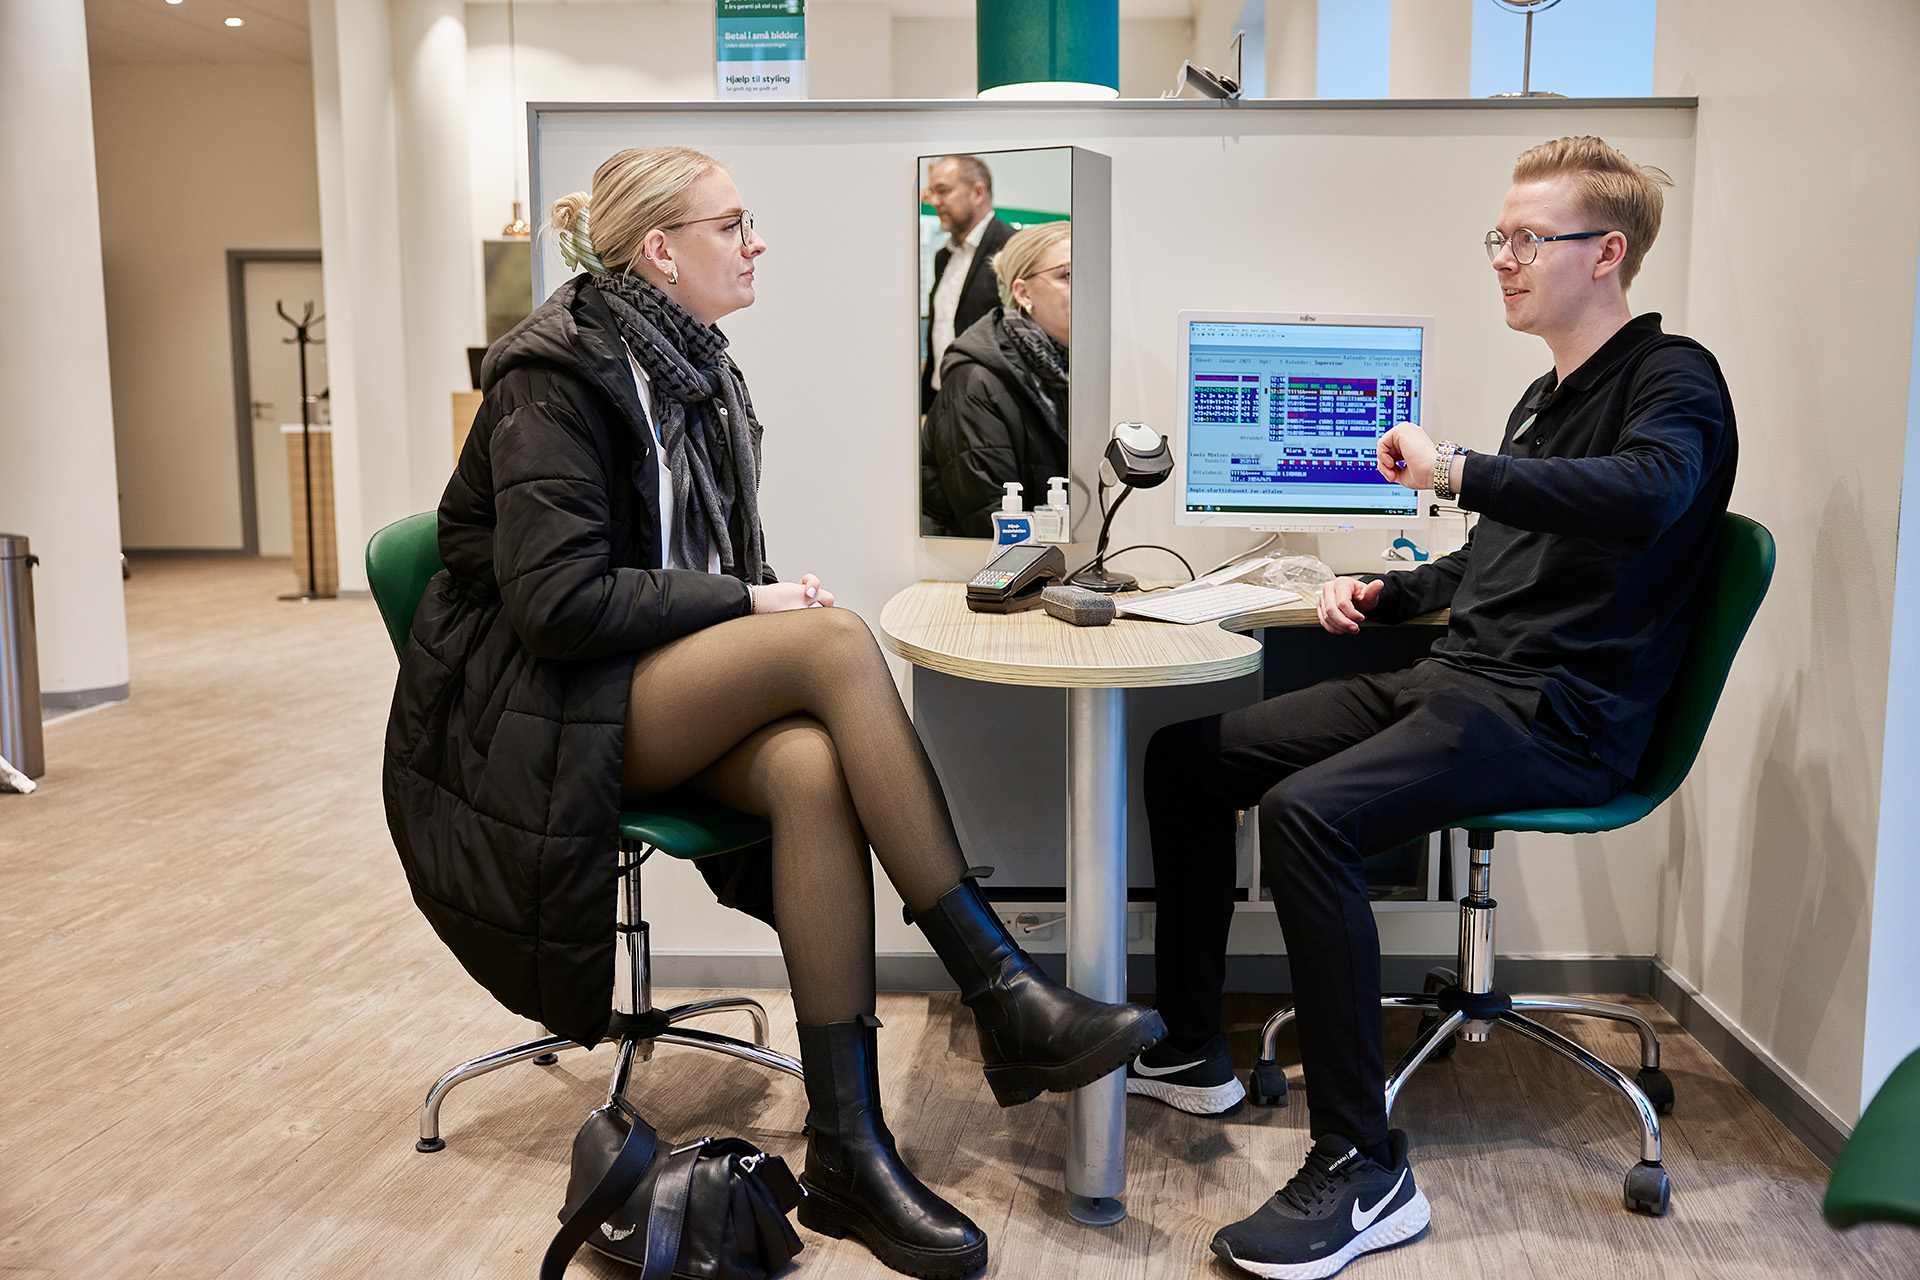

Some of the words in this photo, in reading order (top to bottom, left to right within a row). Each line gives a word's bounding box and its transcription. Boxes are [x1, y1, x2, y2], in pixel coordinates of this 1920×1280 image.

[725, 32, 746, 40] Betal
[748, 32, 751, 40] i
[752, 30, 769, 40] små
[771, 30, 799, 39] bidder
[726, 75, 750, 84] Hjælp
[762, 75, 790, 84] styling
